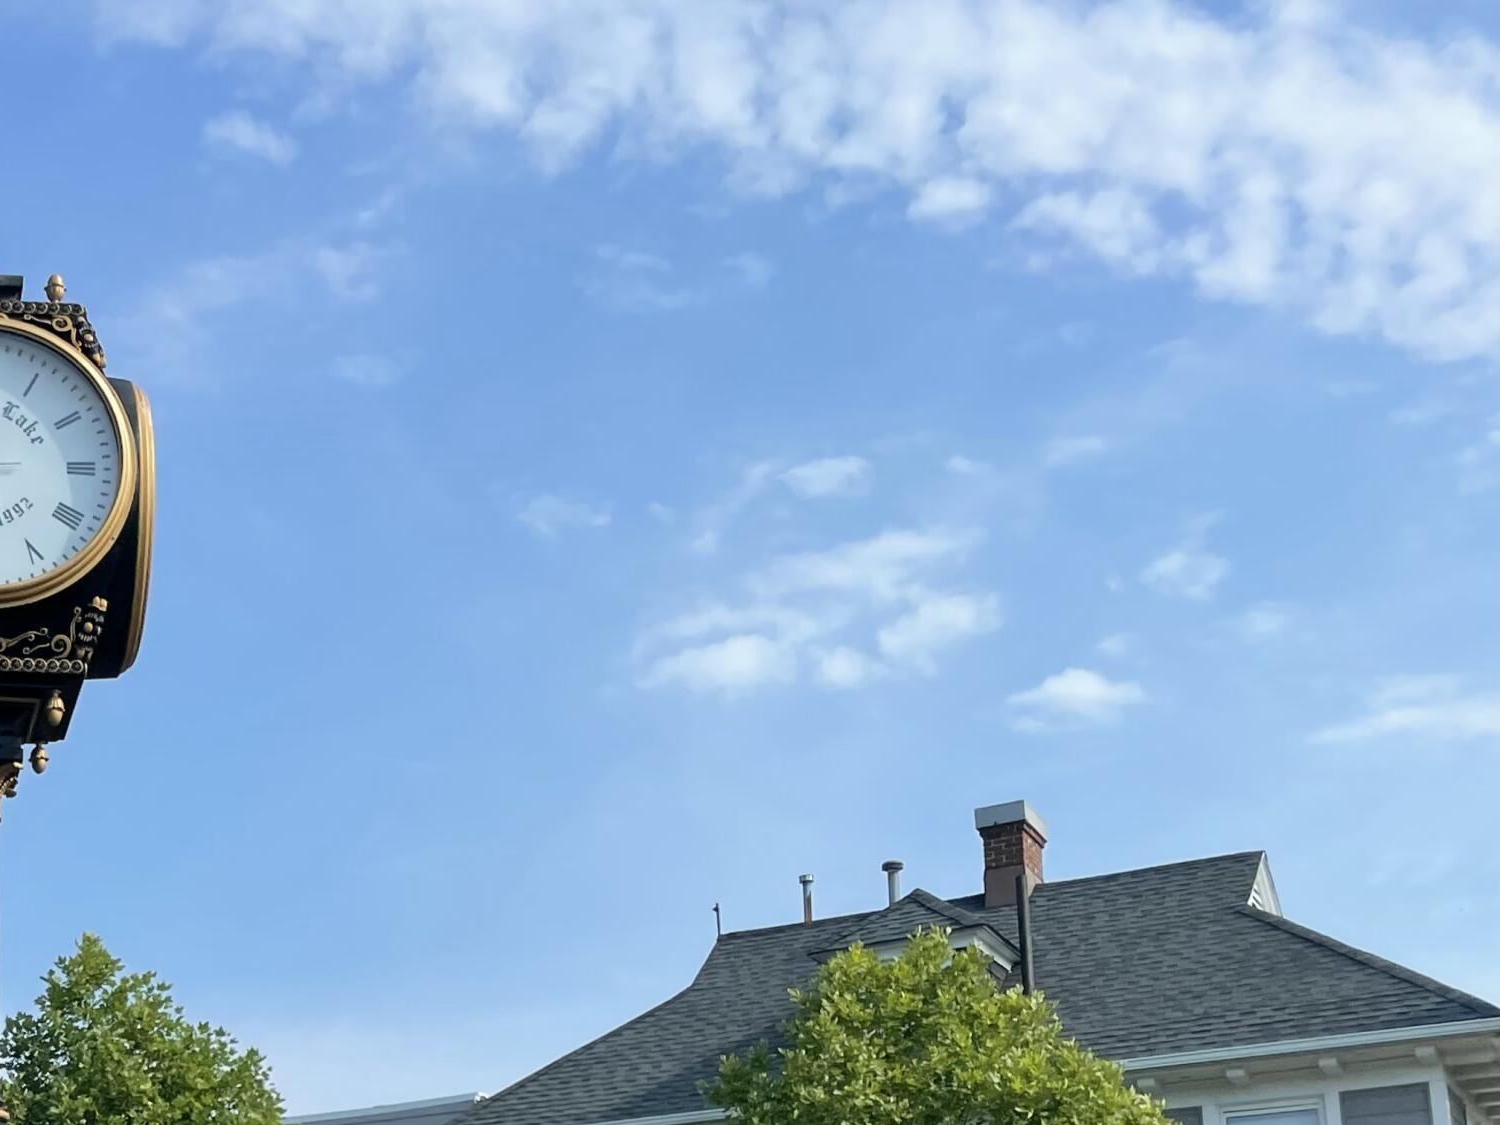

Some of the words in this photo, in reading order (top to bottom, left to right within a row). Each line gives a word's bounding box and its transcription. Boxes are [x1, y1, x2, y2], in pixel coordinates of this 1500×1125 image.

[3, 401, 44, 444] Lake
[53, 410, 82, 430] II
[66, 461, 96, 476] III
[51, 502, 85, 531] IIII
[23, 537, 45, 565] V
